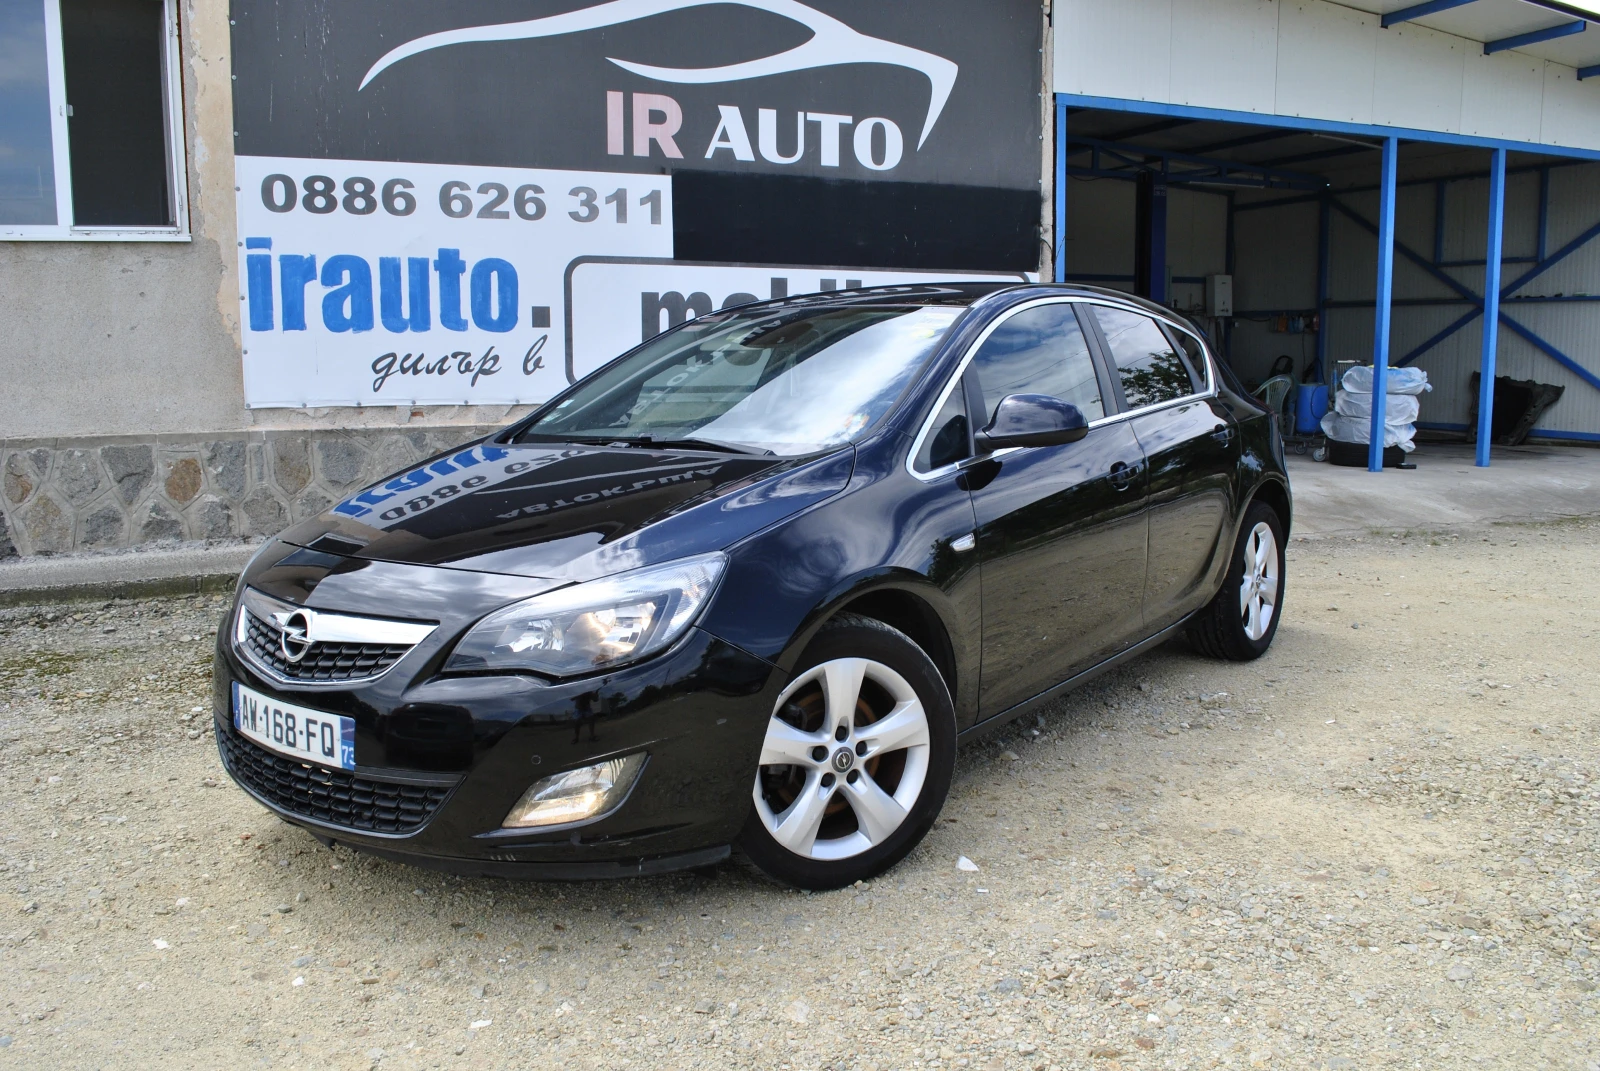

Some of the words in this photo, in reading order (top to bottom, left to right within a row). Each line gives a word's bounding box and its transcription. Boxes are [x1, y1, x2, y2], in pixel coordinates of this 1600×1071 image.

[606, 90, 684, 159] IR
[704, 104, 904, 171] AUTO
[260, 173, 417, 217] 0886
[438, 180, 547, 221] 626
[568, 186, 662, 225] 311
[371, 346, 502, 392] дилър
